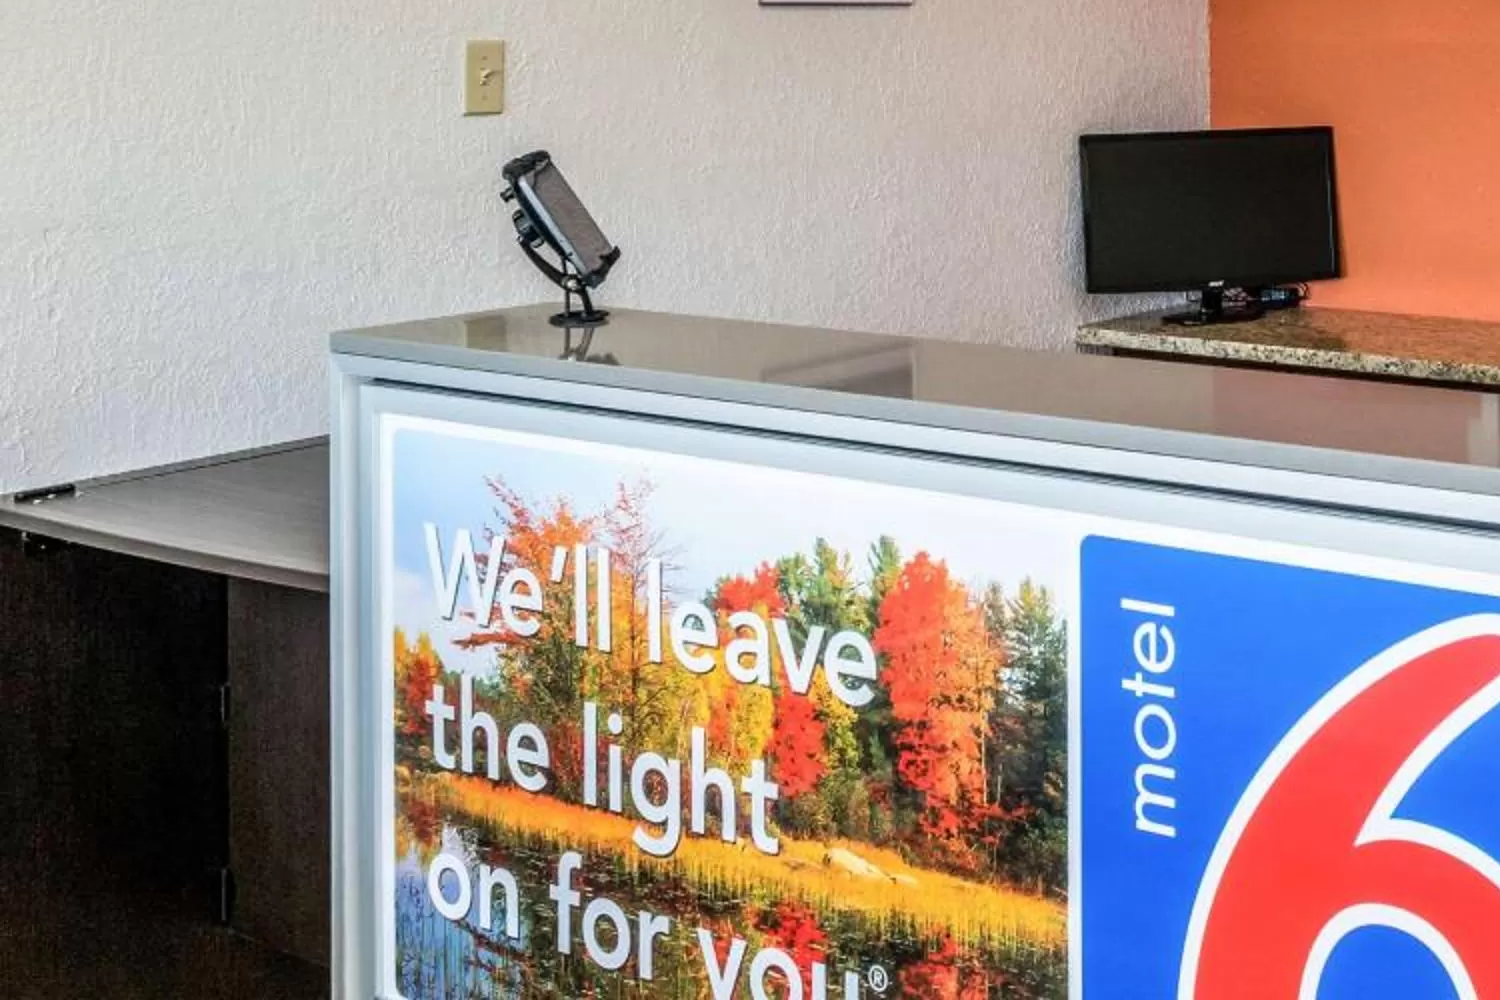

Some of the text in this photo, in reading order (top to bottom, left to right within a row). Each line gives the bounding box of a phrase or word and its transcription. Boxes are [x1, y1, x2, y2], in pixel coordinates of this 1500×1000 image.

[422, 522, 878, 708] We'll leave
[424, 674, 780, 859] the light
[1120, 597, 1176, 838] motel
[426, 848, 522, 940] on
[547, 851, 670, 981] for
